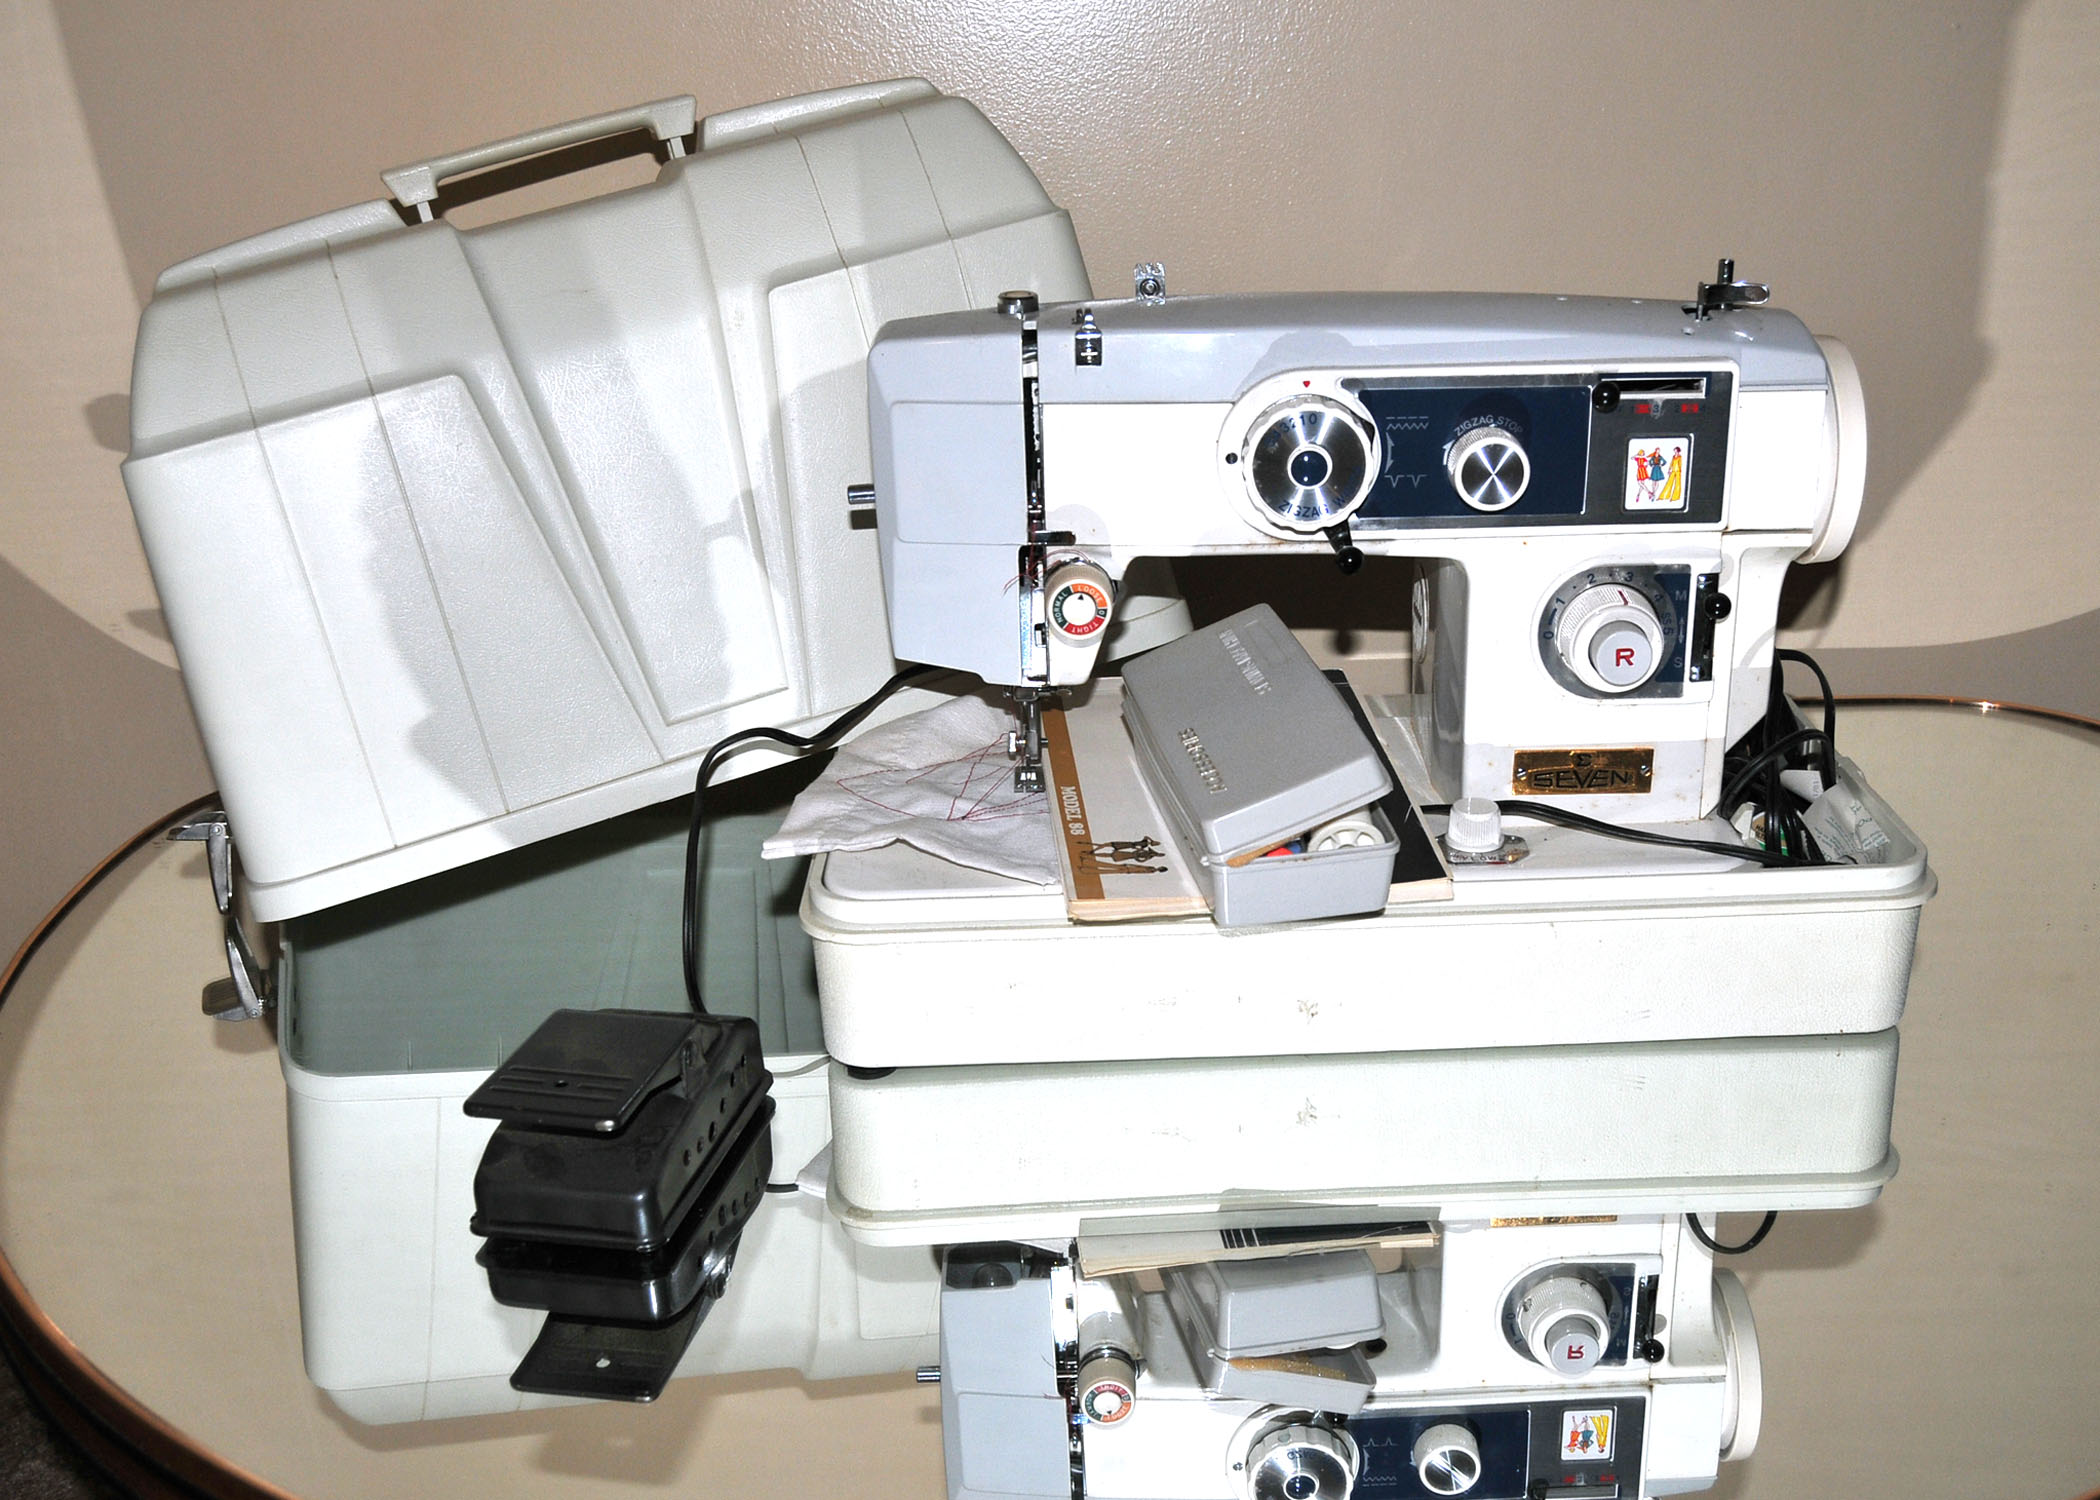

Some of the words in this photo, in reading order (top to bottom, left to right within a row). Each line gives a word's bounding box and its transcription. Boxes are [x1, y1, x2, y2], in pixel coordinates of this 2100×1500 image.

[1280, 422, 1290, 433] 3
[1308, 413, 1318, 424] 0
[1453, 414, 1494, 437] ZIGZAG
[1496, 416, 1524, 433] STOP
[1077, 585, 1104, 604] LOOSE
[1675, 590, 1687, 601] M
[1054, 591, 1069, 623] NORMAL
[1543, 631, 1554, 640] 0
[1556, 597, 1566, 605] 1
[1587, 573, 1597, 584] 2
[1625, 571, 1634, 582] 3
[1071, 621, 1100, 633] TIGHT
[1615, 648, 1635, 667] R
[1673, 657, 1683, 668] S
[1534, 769, 1629, 789] SEVEN
[1060, 786, 1082, 821] MODEL
[1068, 823, 1086, 835] 88
